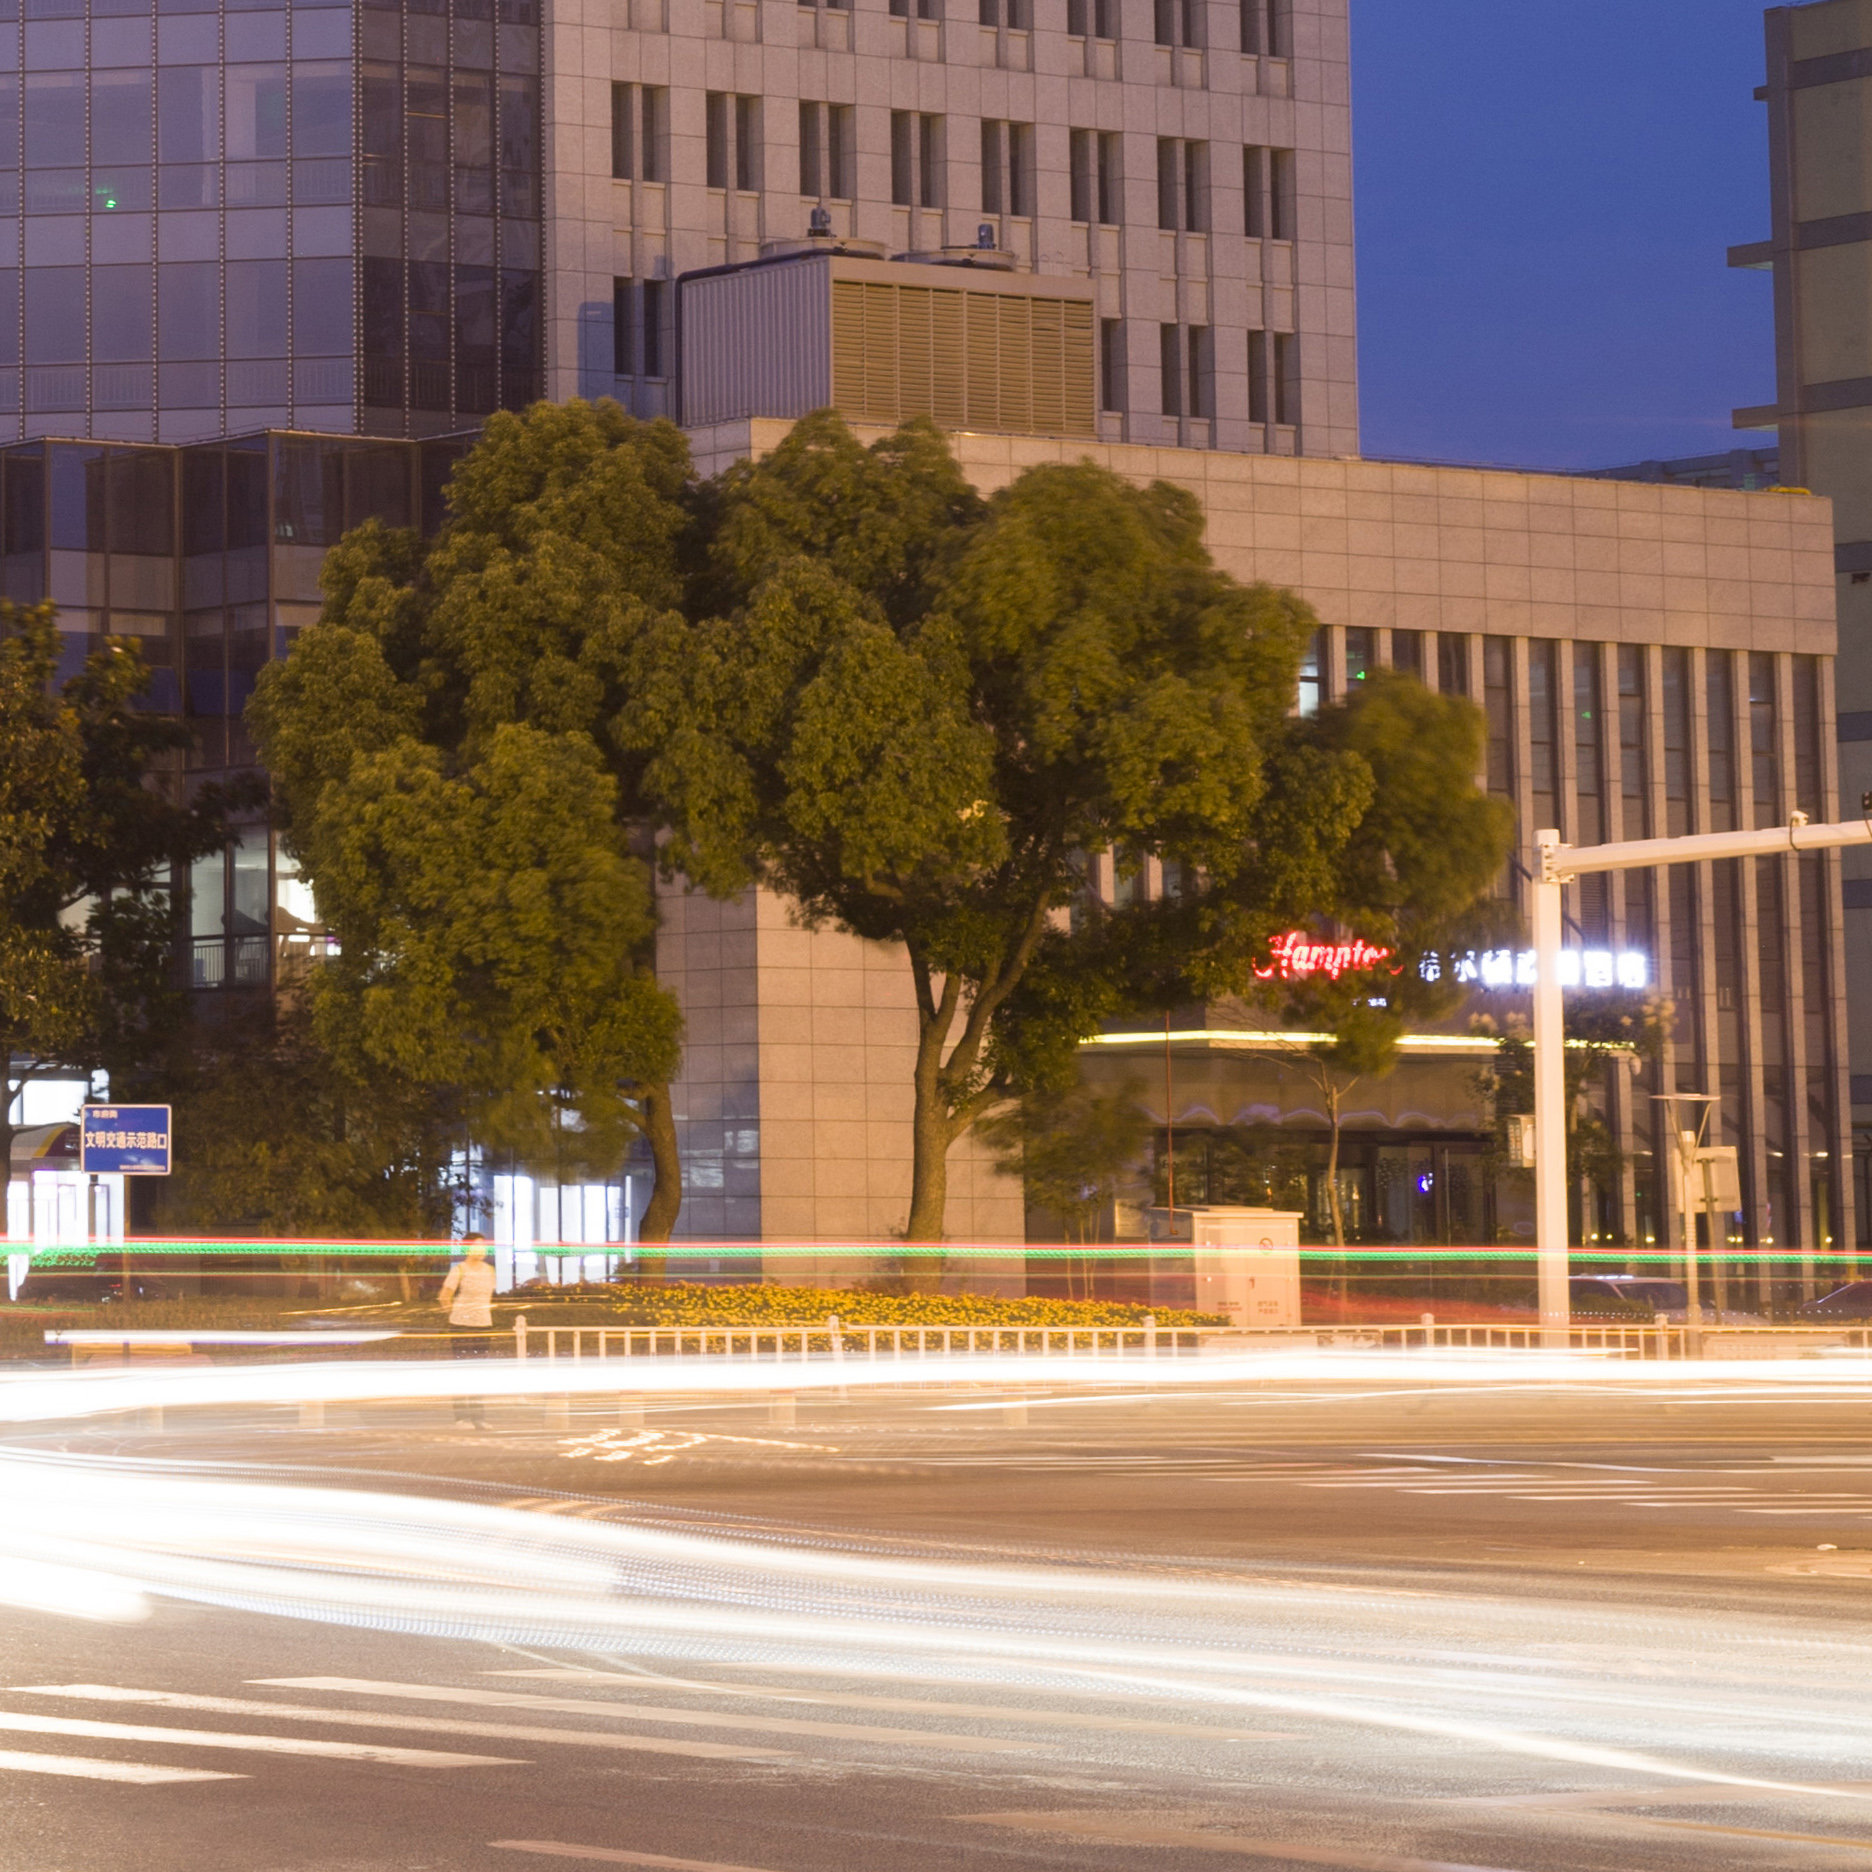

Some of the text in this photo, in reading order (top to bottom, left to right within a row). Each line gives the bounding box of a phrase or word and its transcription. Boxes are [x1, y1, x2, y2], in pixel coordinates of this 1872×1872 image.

[1253, 931, 1404, 979] Hampto
[85, 1131, 167, 1149] 文明交通示范路口
